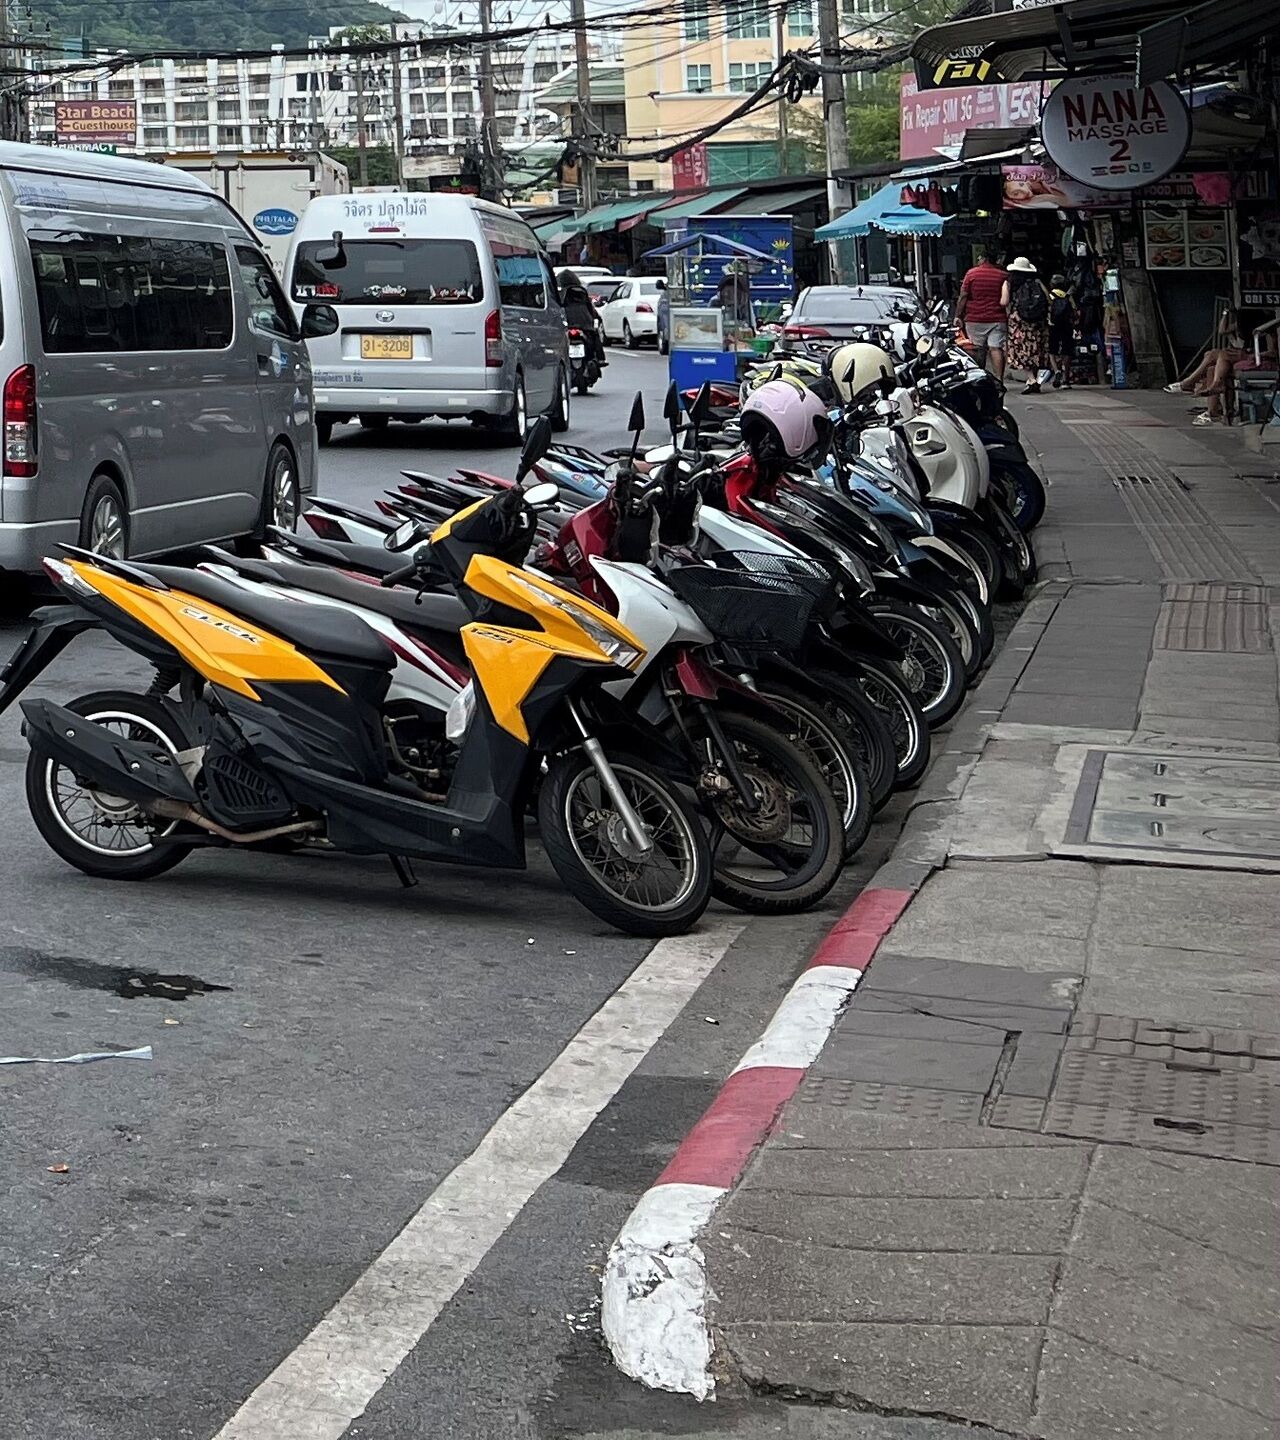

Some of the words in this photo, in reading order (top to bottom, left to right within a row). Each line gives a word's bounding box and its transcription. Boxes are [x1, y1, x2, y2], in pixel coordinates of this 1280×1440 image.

[57, 106, 87, 119] Star
[90, 105, 135, 118] Beach
[1009, 85, 1032, 121] 5G
[1062, 86, 1166, 128] NANA
[72, 121, 136, 131] Guesthouse
[902, 105, 914, 131] Fix
[915, 100, 941, 134] Repair
[942, 97, 958, 125] SIM
[1067, 119, 1169, 142] MASSAGE
[1108, 138, 1132, 162] 2
[363, 339, 410, 353] 31-3209
